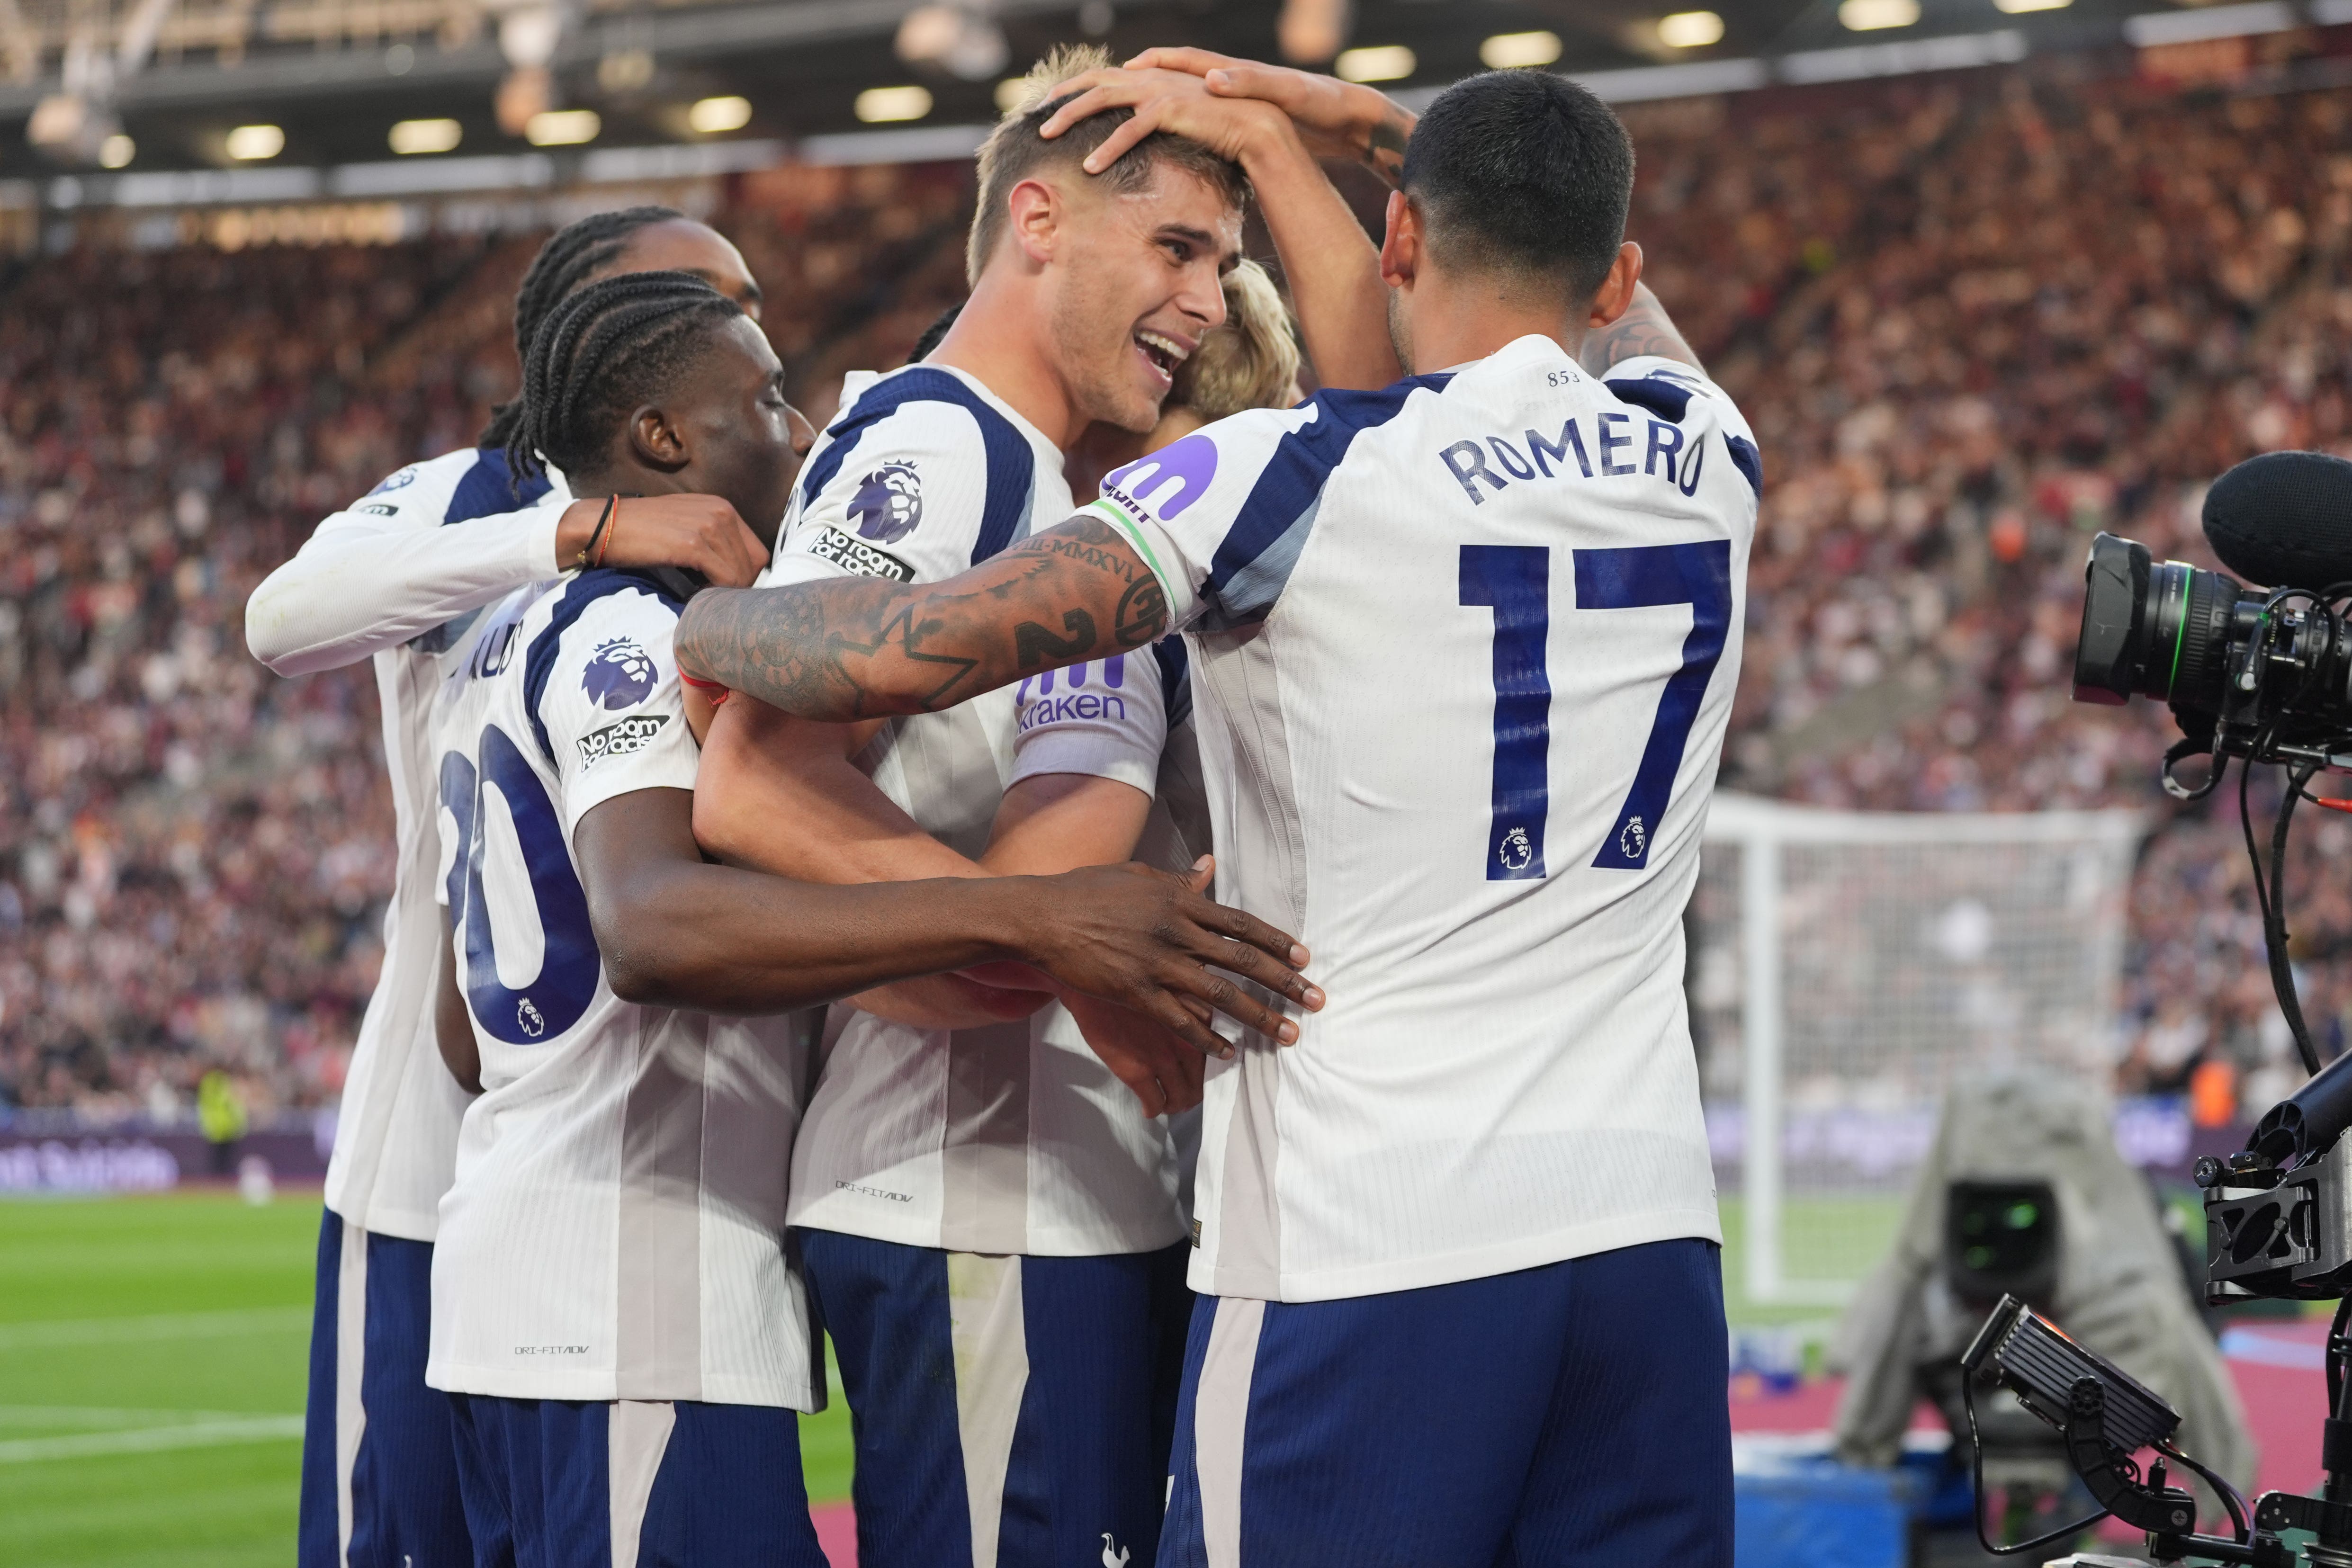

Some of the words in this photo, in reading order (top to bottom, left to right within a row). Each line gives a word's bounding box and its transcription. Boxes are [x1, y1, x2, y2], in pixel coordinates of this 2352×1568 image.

[1547, 371, 1580, 387] 853
[1439, 412, 1705, 506] ROMERO
[808, 539, 841, 558] for
[817, 527, 849, 547] No
[847, 541, 903, 581] room
[1019, 694, 1125, 734] kraken
[1458, 539, 1732, 880] 17
[577, 735, 606, 757] No
[608, 719, 661, 742] room
[603, 735, 655, 755] racis
[835, 1180, 914, 1202] DRI-FITADV
[515, 1345, 590, 1354] DRI-FITADV
